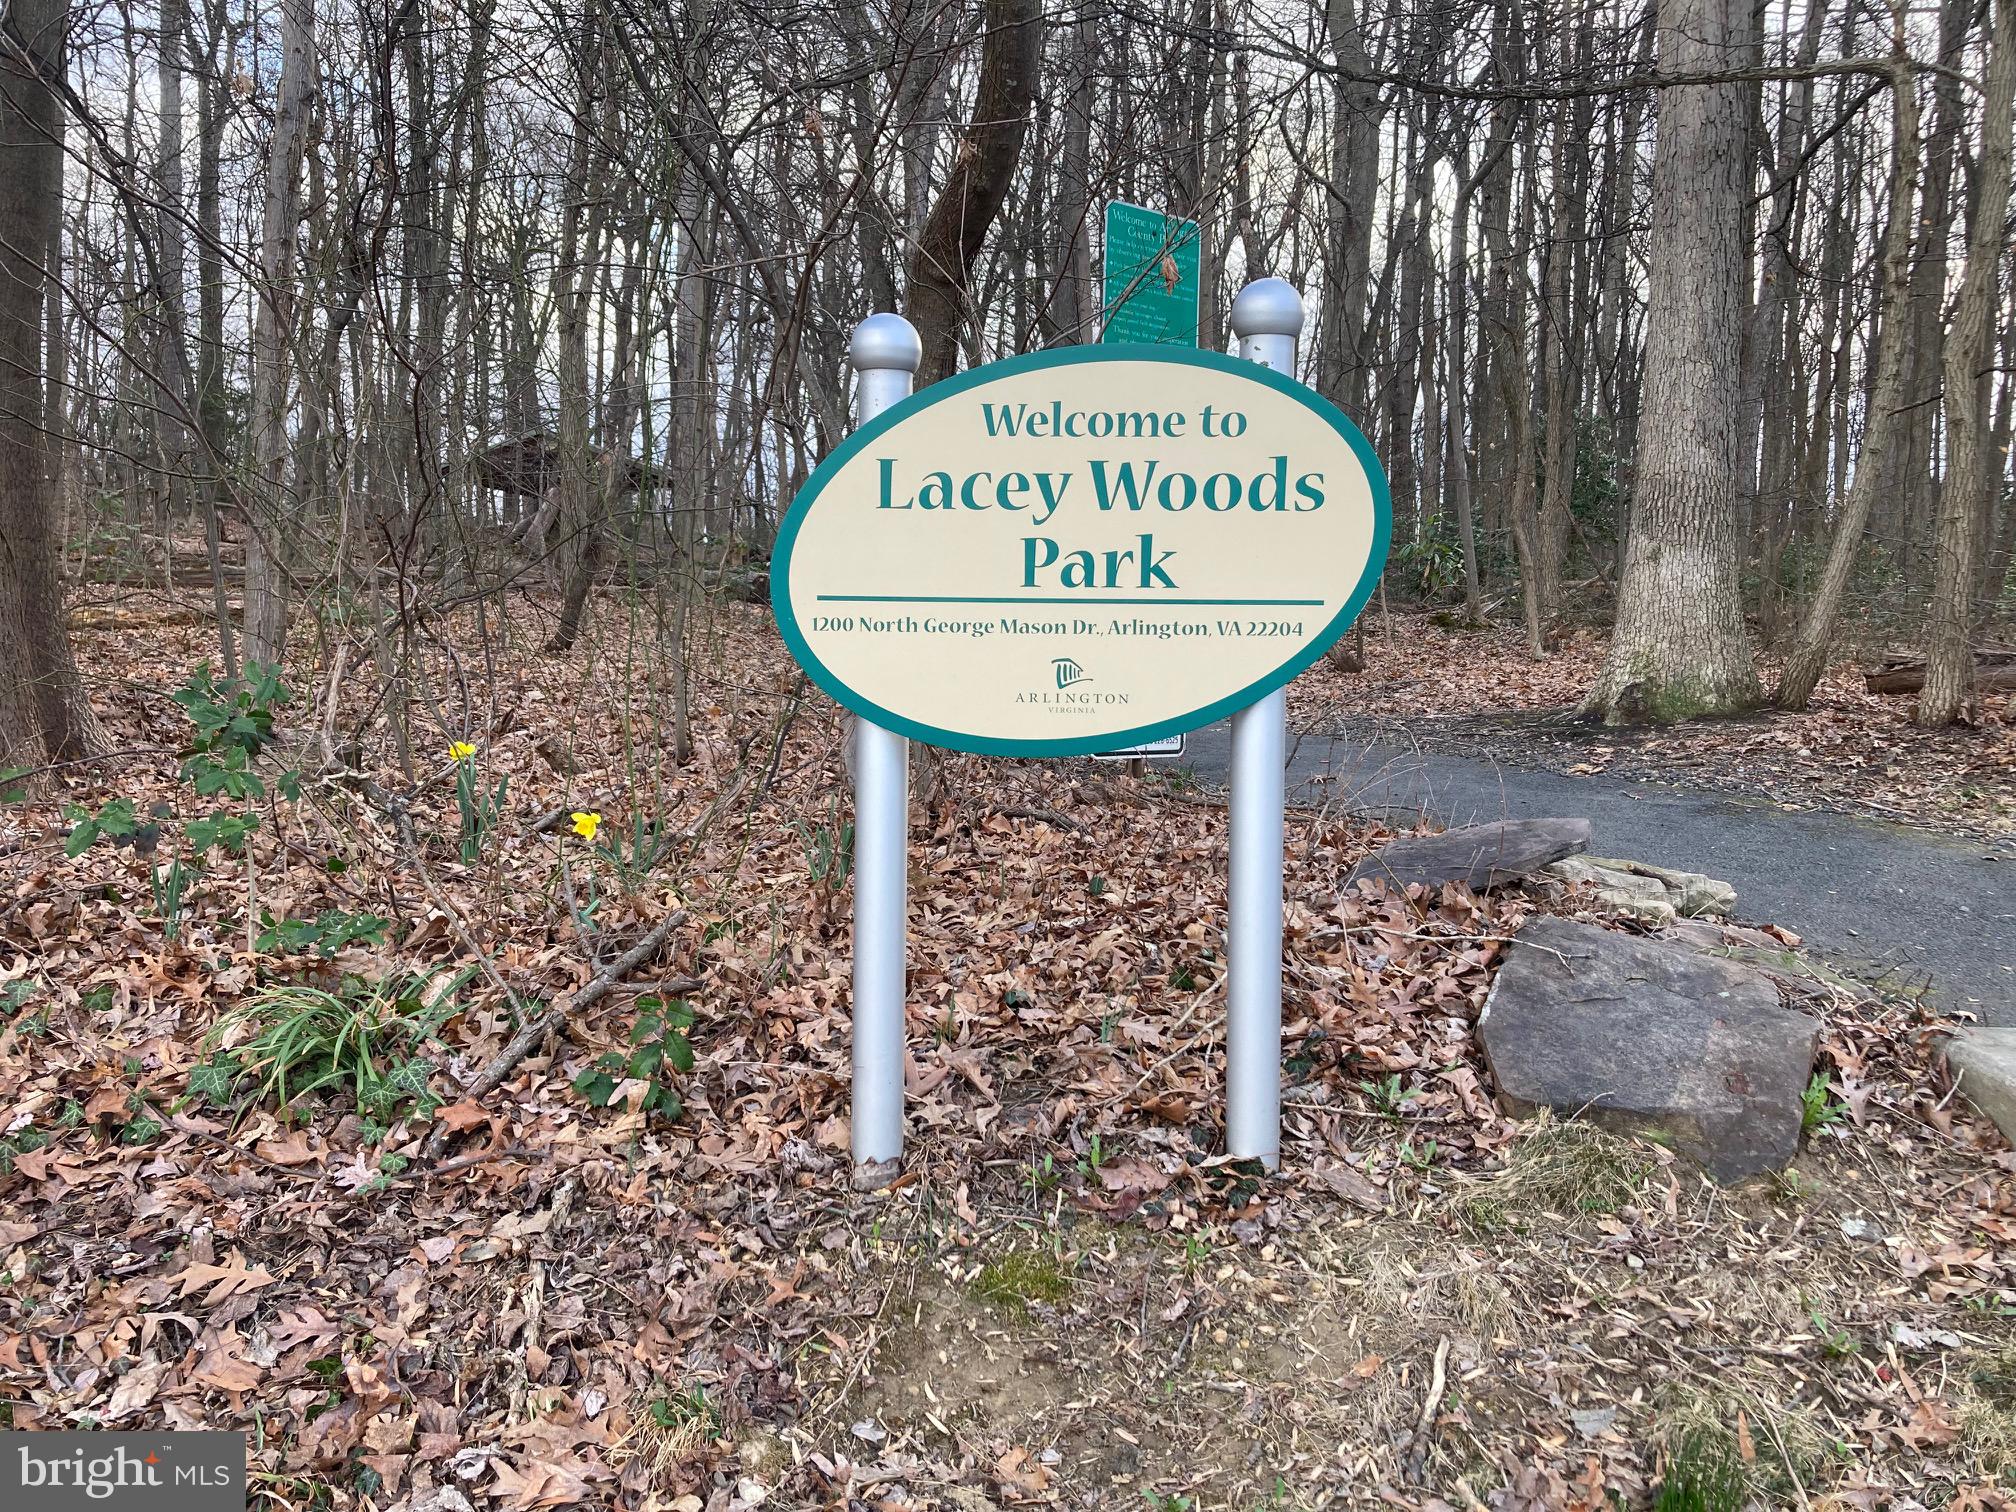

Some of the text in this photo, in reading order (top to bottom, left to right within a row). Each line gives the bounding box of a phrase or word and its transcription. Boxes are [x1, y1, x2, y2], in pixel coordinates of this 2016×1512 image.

[981, 400, 1248, 438] Welcome to
[876, 455, 1325, 526] Lacey Woods
[1020, 533, 1180, 589] Park
[812, 616, 1304, 640] 1200 North George Mason Dr., Arlington, VA 22204
[1015, 692, 1129, 705] ARLINGTON
[1048, 706, 1096, 714] VIRGINIA
